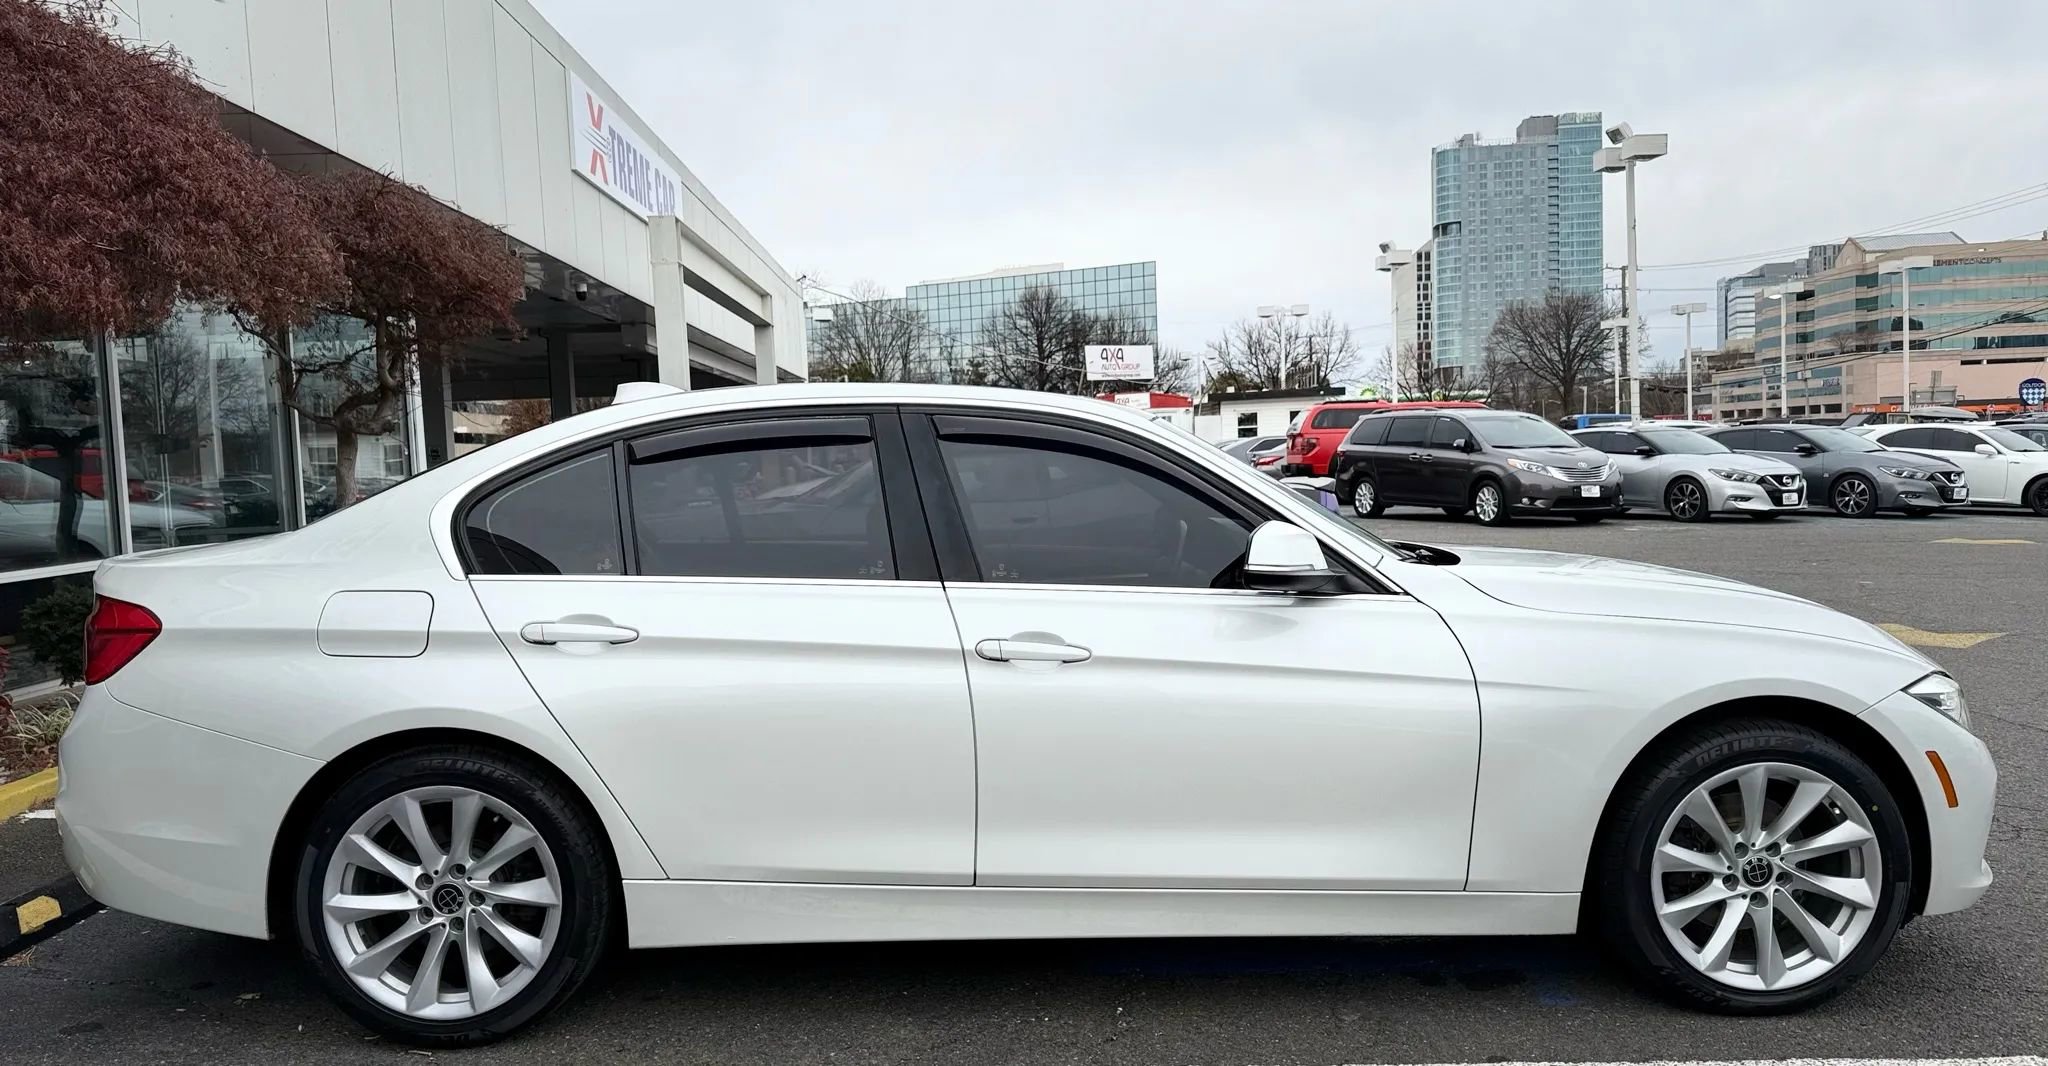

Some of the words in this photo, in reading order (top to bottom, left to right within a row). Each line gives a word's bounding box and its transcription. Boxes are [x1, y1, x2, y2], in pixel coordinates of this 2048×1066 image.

[654, 167, 676, 218] CAR
[1101, 363, 1117, 371] AUTO
[1120, 362, 1141, 371] GROUP
